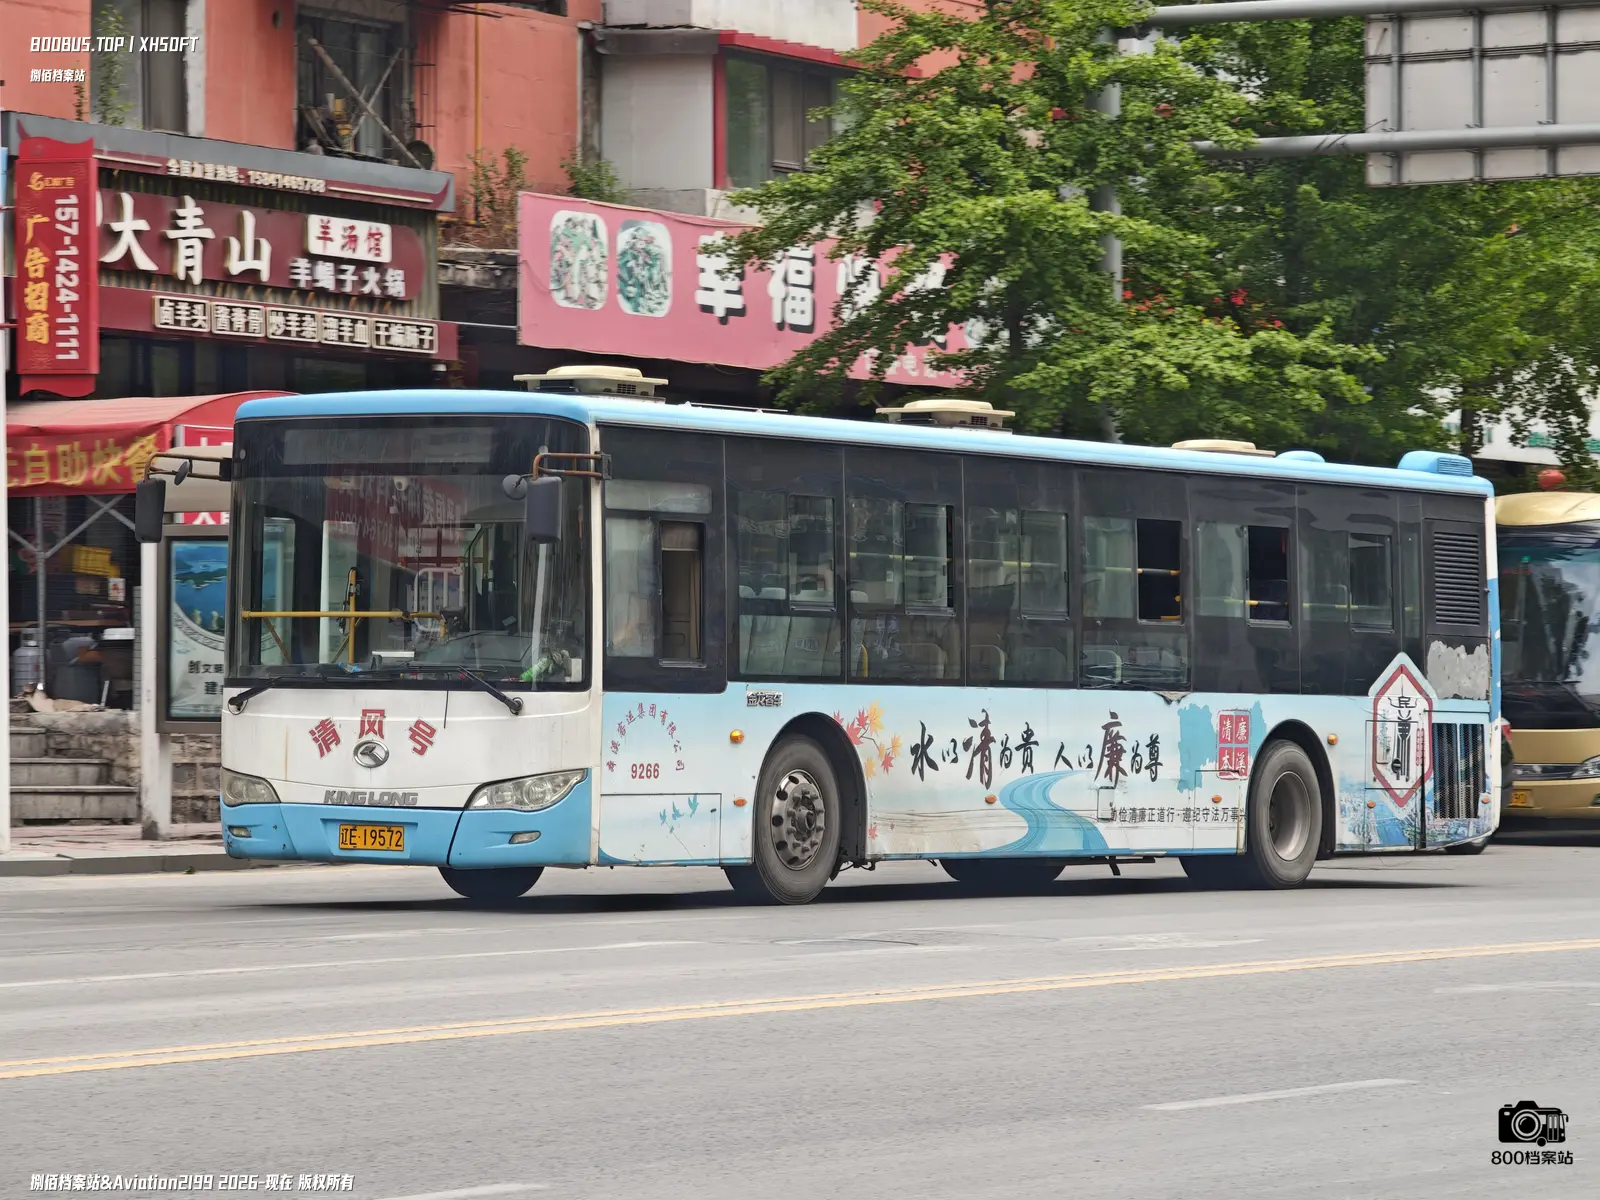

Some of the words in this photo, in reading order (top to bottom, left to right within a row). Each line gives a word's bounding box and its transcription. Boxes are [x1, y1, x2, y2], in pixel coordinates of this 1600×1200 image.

[99, 192, 272, 285] 大青山
[316, 218, 384, 257] 羊汤馆
[24, 213, 50, 345] 广告招商
[55, 194, 79, 360] 157-1424-1111
[289, 257, 406, 298] 羊蝎子火锅
[308, 708, 437, 758] 清风号
[631, 763, 660, 780] 9266
